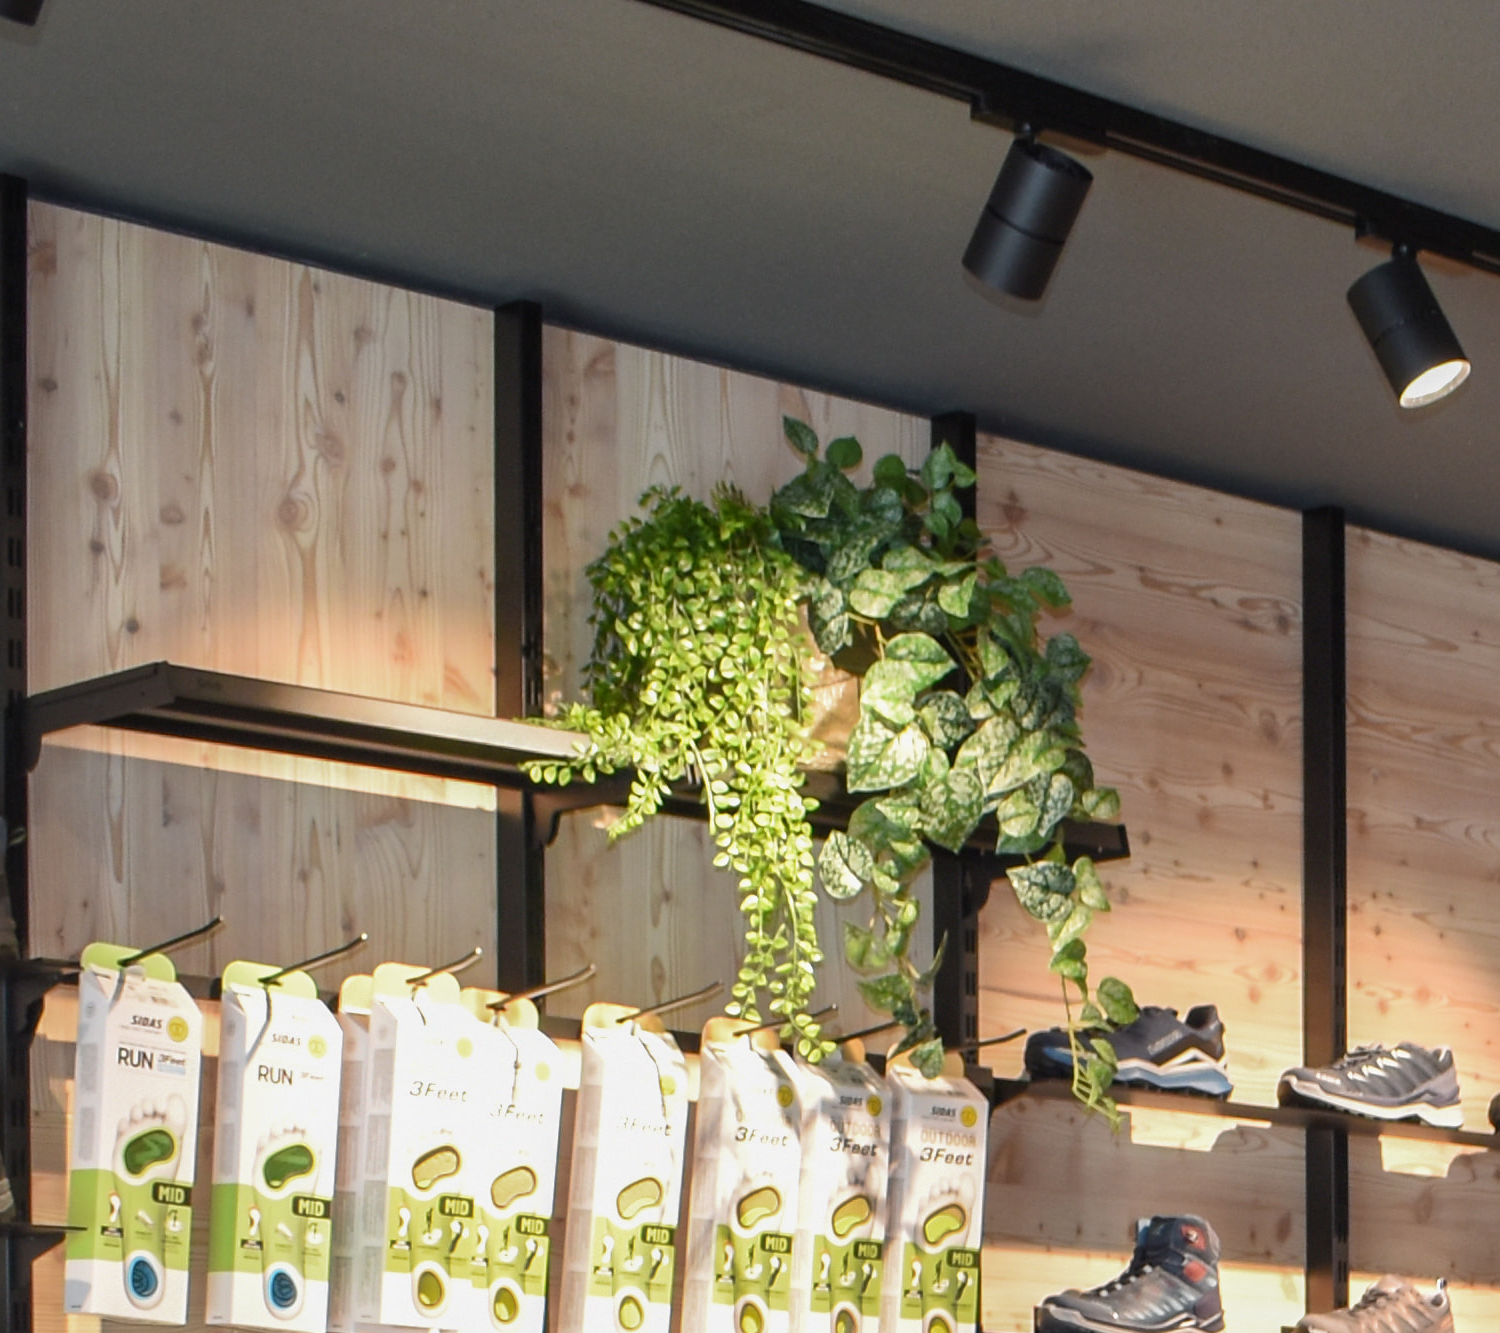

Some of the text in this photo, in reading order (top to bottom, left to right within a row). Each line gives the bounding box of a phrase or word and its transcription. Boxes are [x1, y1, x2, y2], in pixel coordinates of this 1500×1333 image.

[117, 1047, 154, 1070] RUN
[257, 1064, 293, 1085] RUN
[409, 1081, 468, 1103] 3Feet
[830, 1136, 878, 1157] 3Feet
[920, 1146, 973, 1166] 3Feet
[158, 1185, 186, 1203] MID
[299, 1200, 326, 1217] MID
[445, 1199, 470, 1216] MID
[521, 1217, 544, 1235] MID
[646, 1228, 670, 1244] MID
[765, 1236, 788, 1253] MID
[857, 1243, 878, 1260] MID
[952, 1251, 974, 1267] MID
